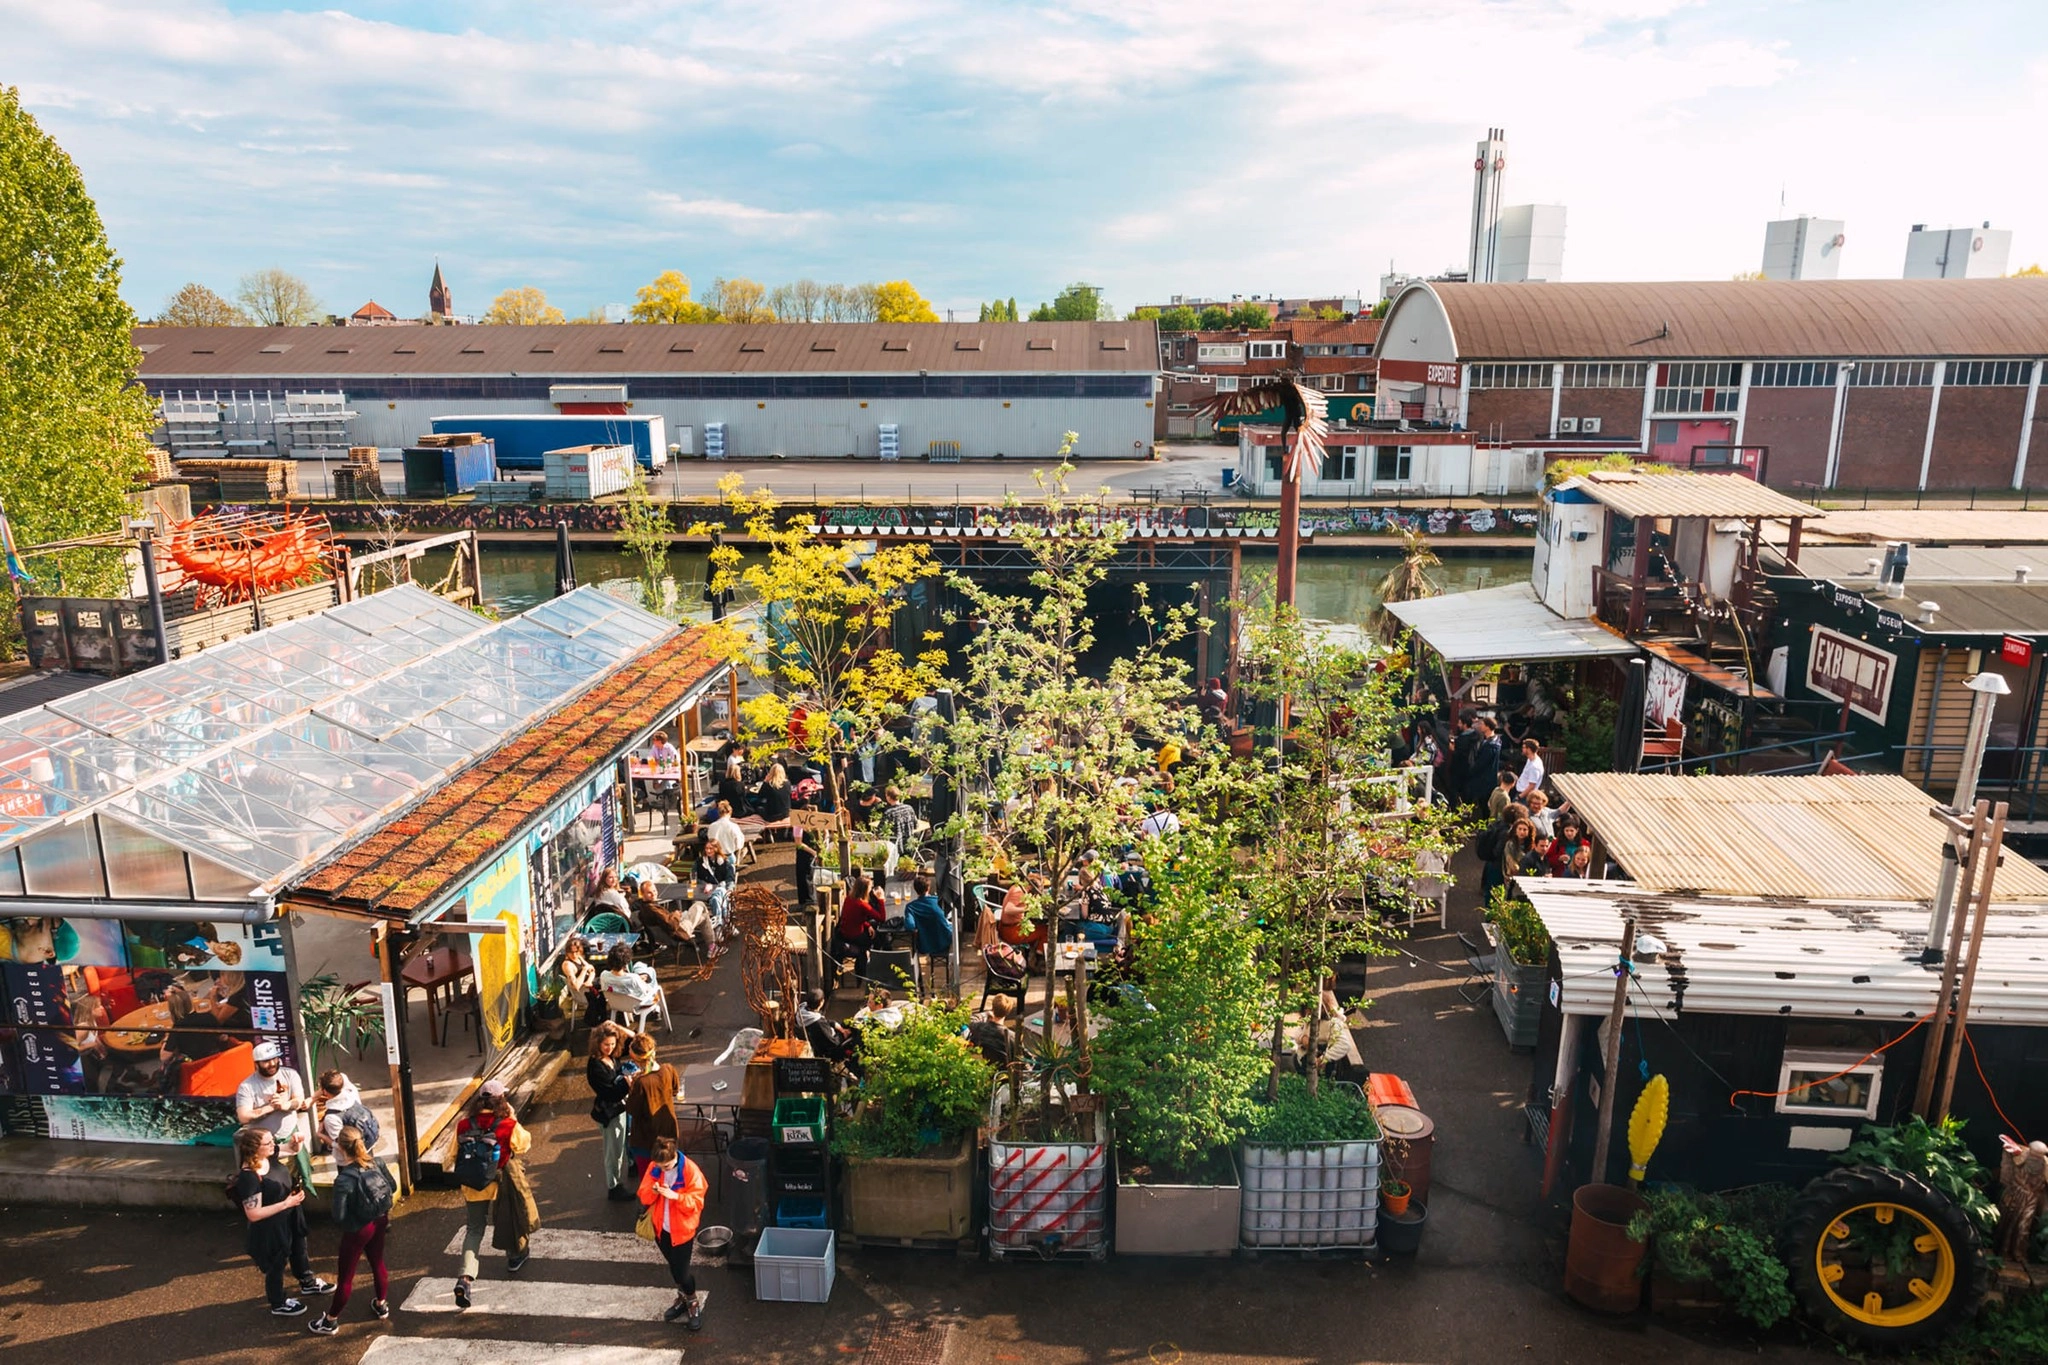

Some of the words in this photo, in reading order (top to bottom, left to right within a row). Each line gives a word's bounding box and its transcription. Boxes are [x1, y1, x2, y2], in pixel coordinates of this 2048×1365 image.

[1428, 364, 1457, 384] EXPEDITIE
[1835, 591, 1862, 609] EXPOSITIE
[1877, 613, 1903, 630] MUSEUM
[797, 813, 816, 827] WC
[275, 1000, 287, 1020] AKIN
[278, 1022, 288, 1044] FAIH
[43, 1046, 60, 1090] DIANE
